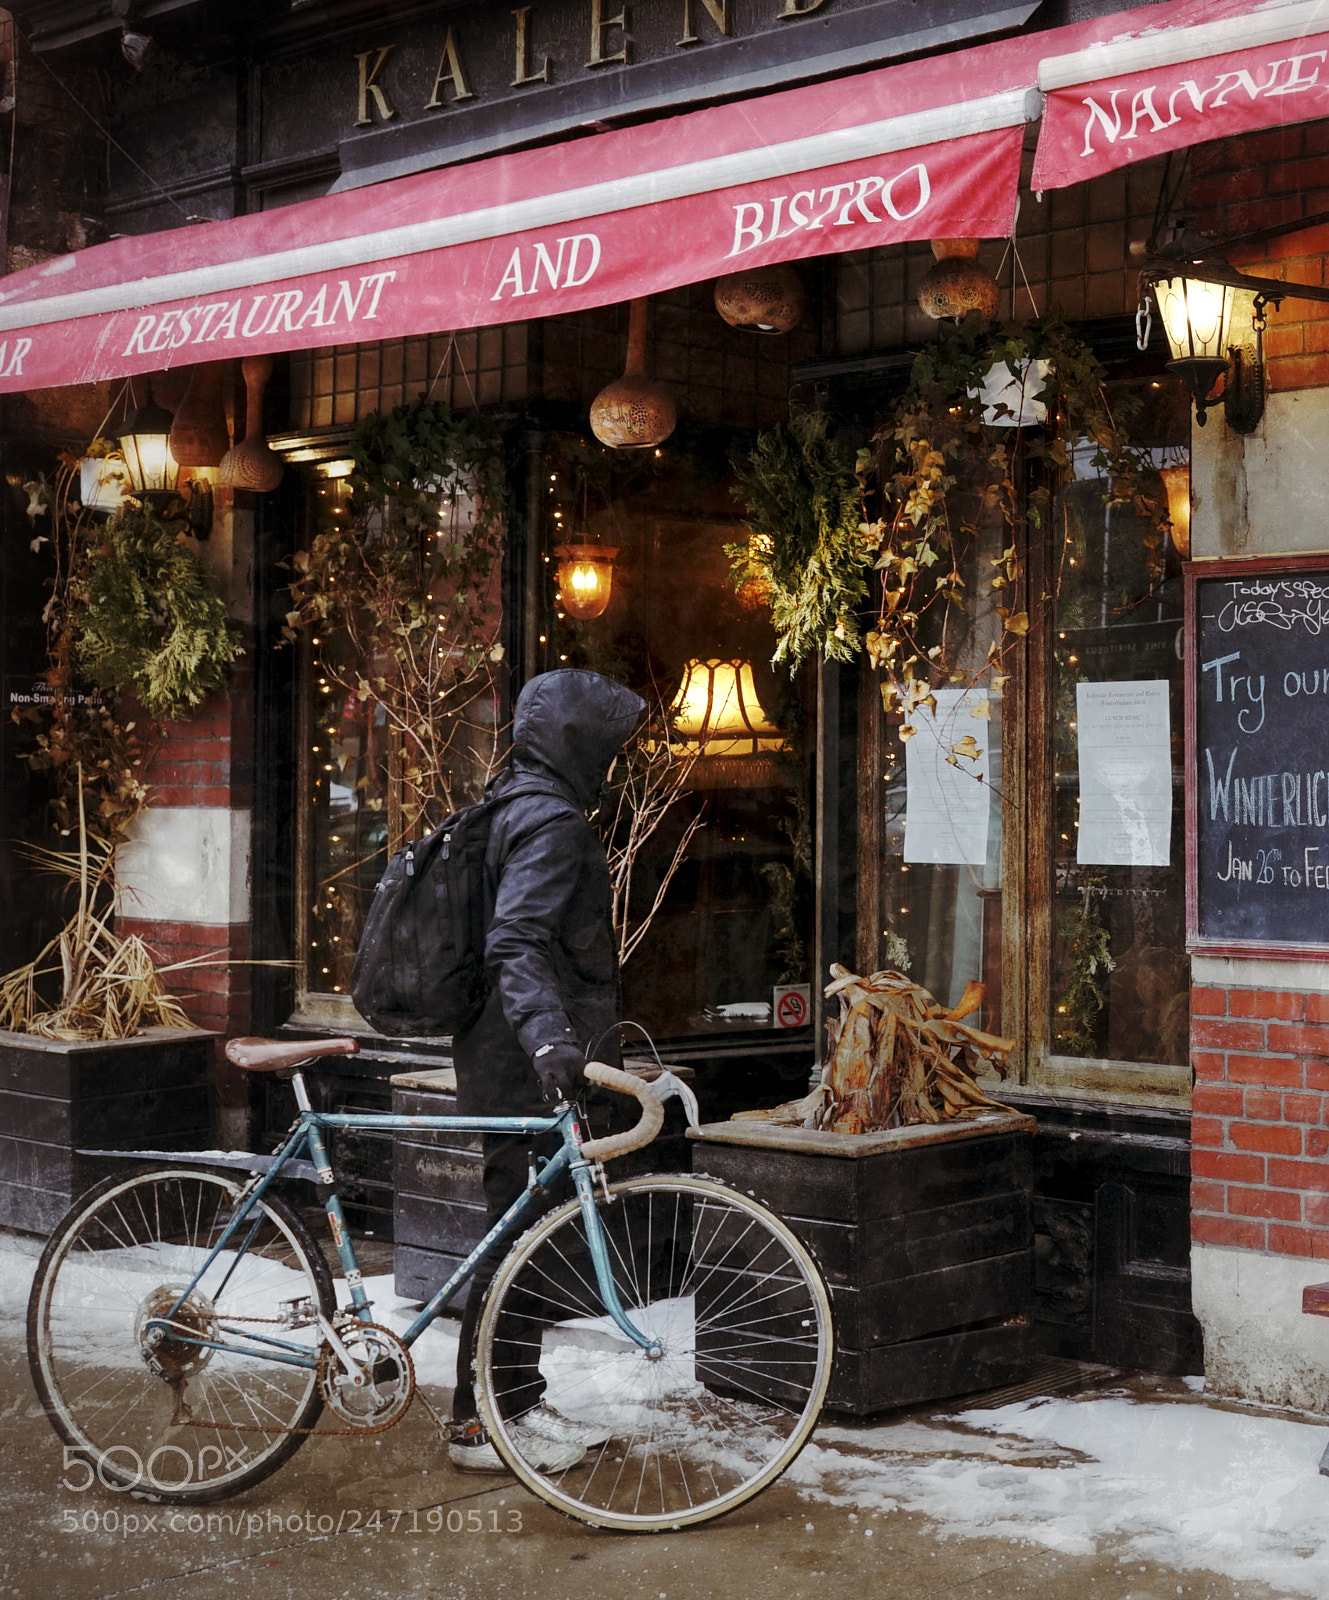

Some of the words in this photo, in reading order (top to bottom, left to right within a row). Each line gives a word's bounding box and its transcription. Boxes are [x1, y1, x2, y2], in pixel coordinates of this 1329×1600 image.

[353, 0, 825, 127] KALEN
[1080, 50, 1329, 158] NANNE
[121, 270, 397, 357] RESTAURANT
[490, 232, 601, 302] AND
[723, 163, 931, 260] BISTRO
[1202, 650, 1265, 733] Try
[1205, 746, 1329, 828] WINTERLIC
[1217, 840, 1253, 882] JAN
[1304, 846, 1329, 890] FE
